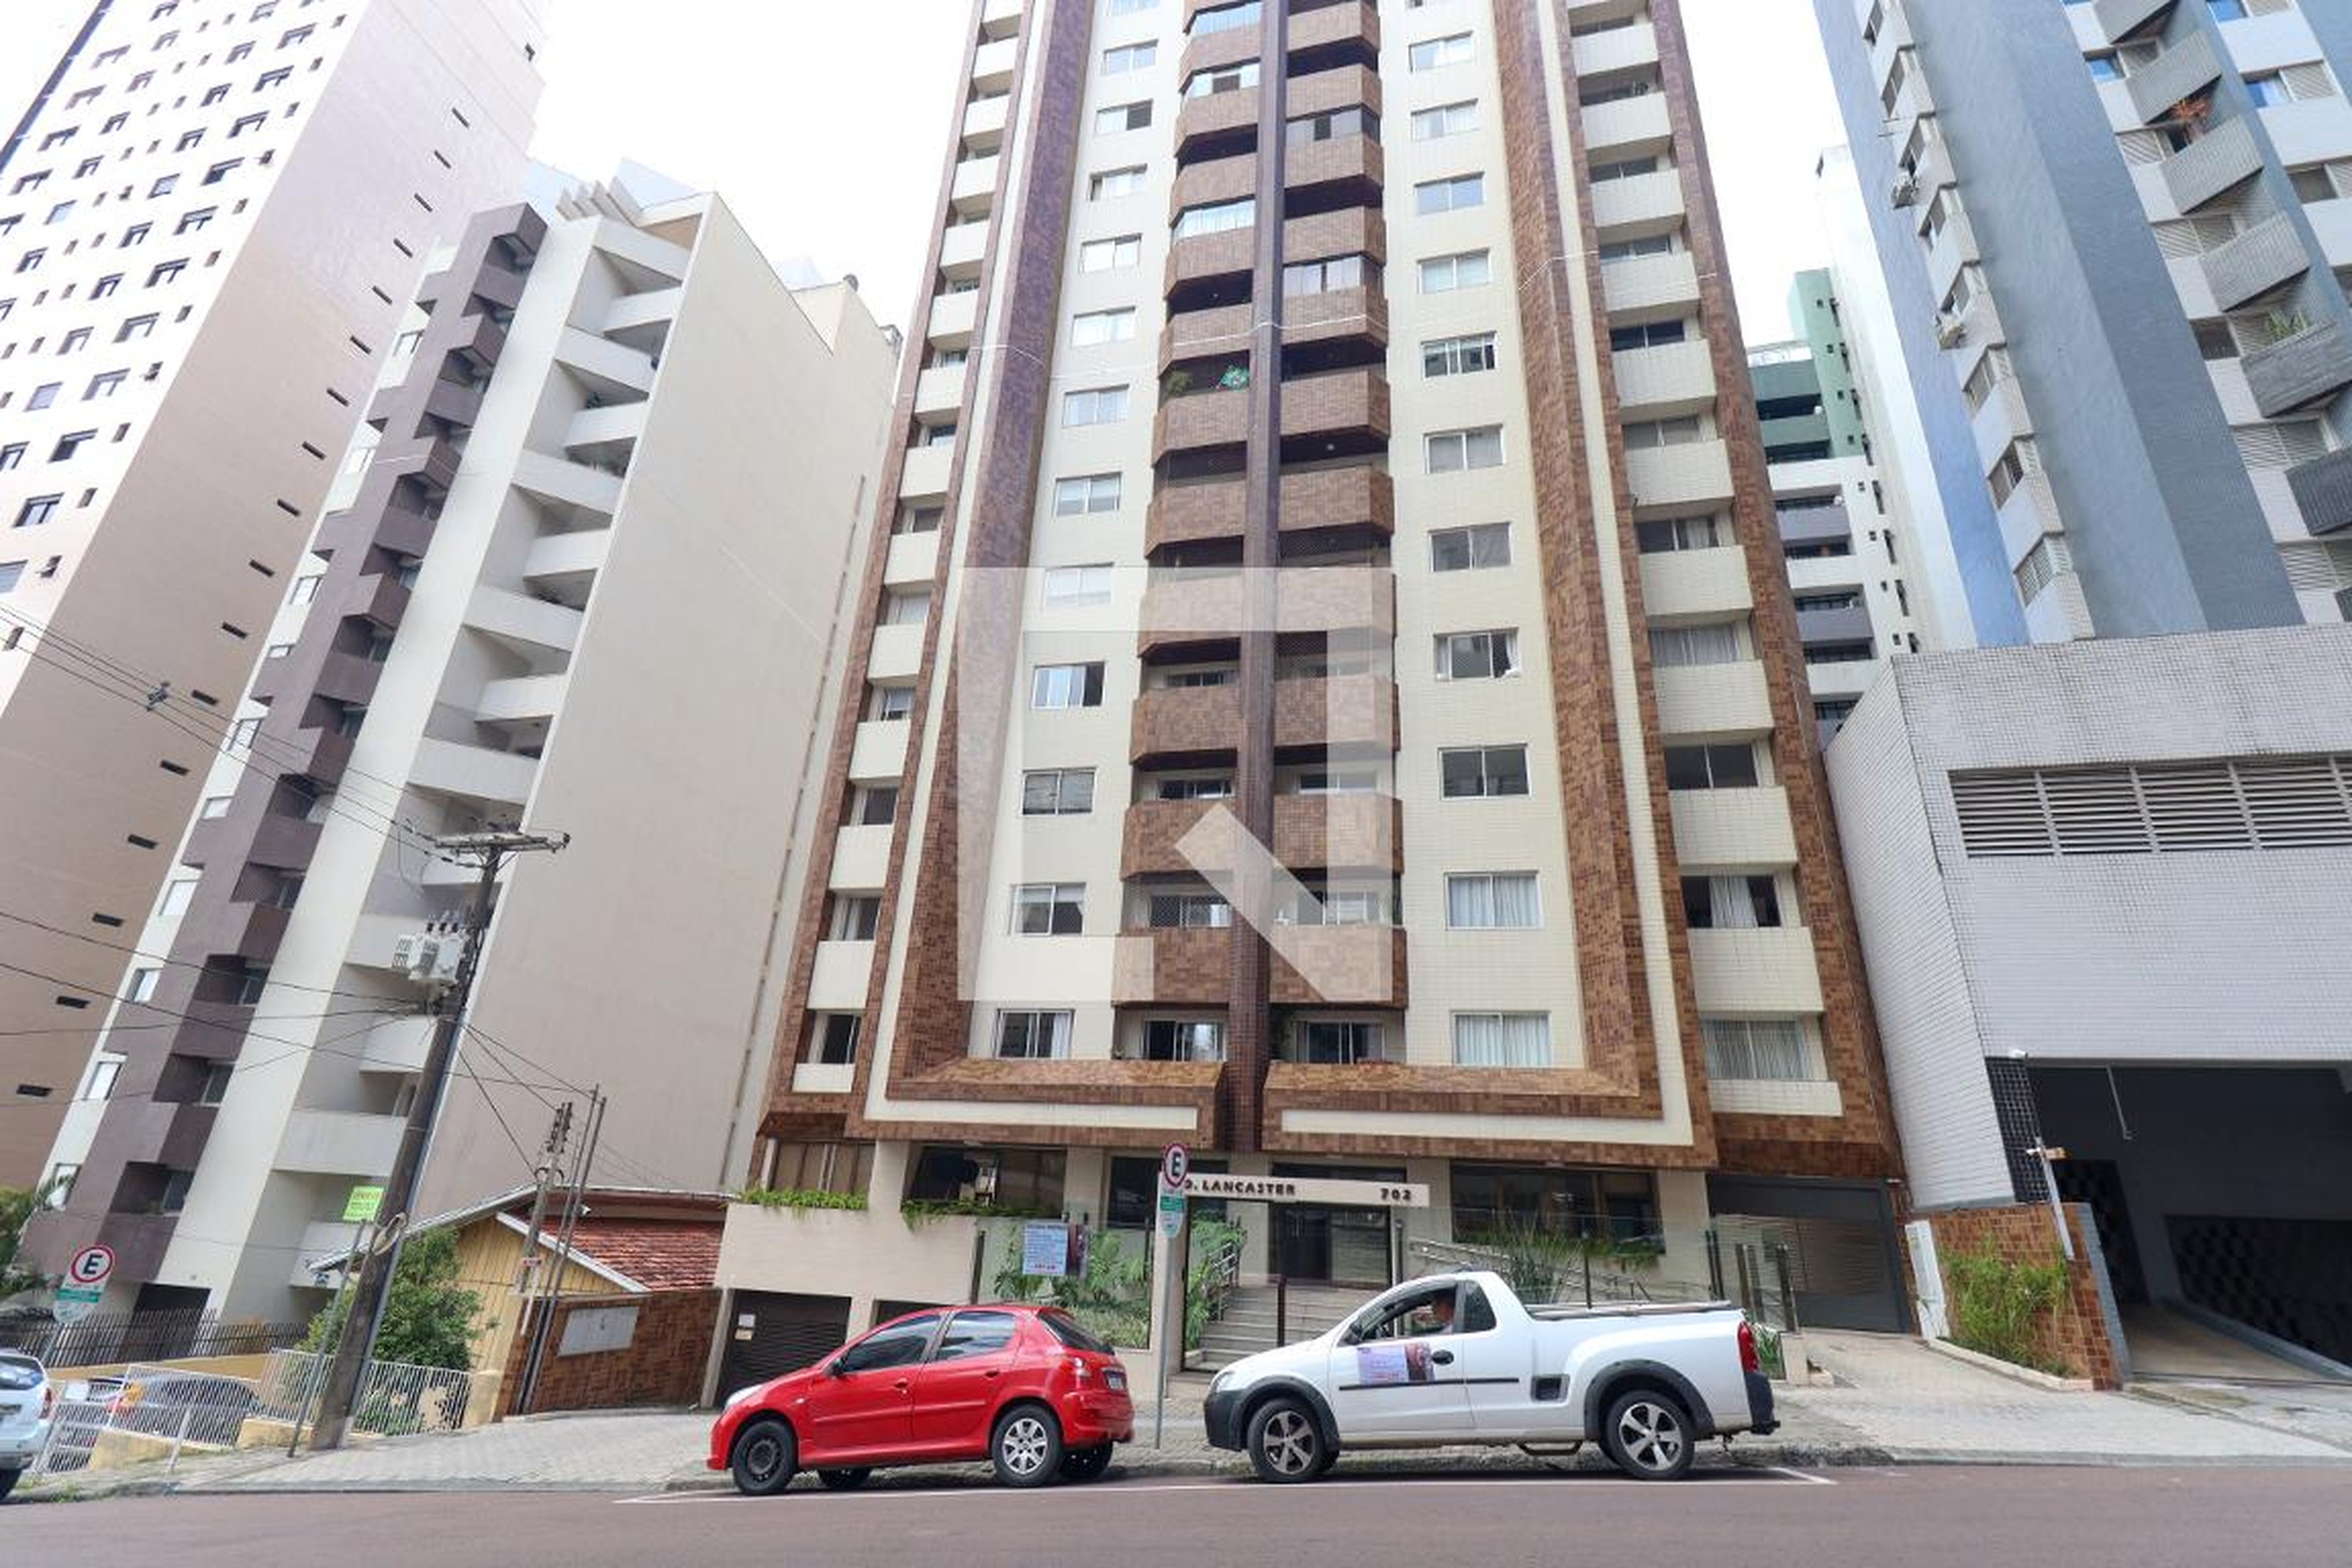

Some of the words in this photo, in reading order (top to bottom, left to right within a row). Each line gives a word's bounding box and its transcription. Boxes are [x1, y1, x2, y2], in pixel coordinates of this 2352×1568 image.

[1171, 1152, 1182, 1177] E
[1202, 1180, 1295, 1195] LANCASTER
[1380, 1188, 1411, 1201] 702
[83, 1254, 104, 1274] E
